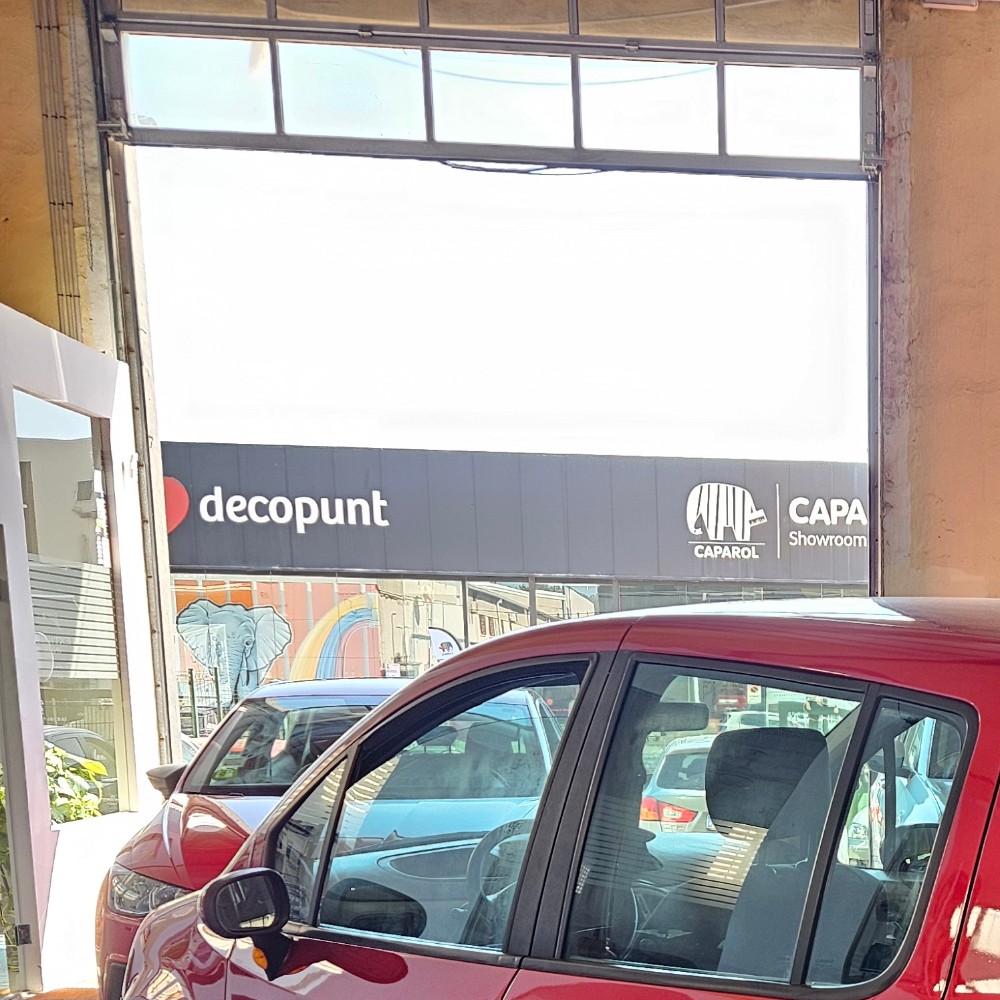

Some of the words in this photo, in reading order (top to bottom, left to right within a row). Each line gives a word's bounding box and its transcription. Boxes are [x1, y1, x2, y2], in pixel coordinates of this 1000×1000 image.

[199, 486, 390, 534] decopunt
[788, 530, 868, 548] Showroom
[693, 544, 760, 560] CAPAROL
